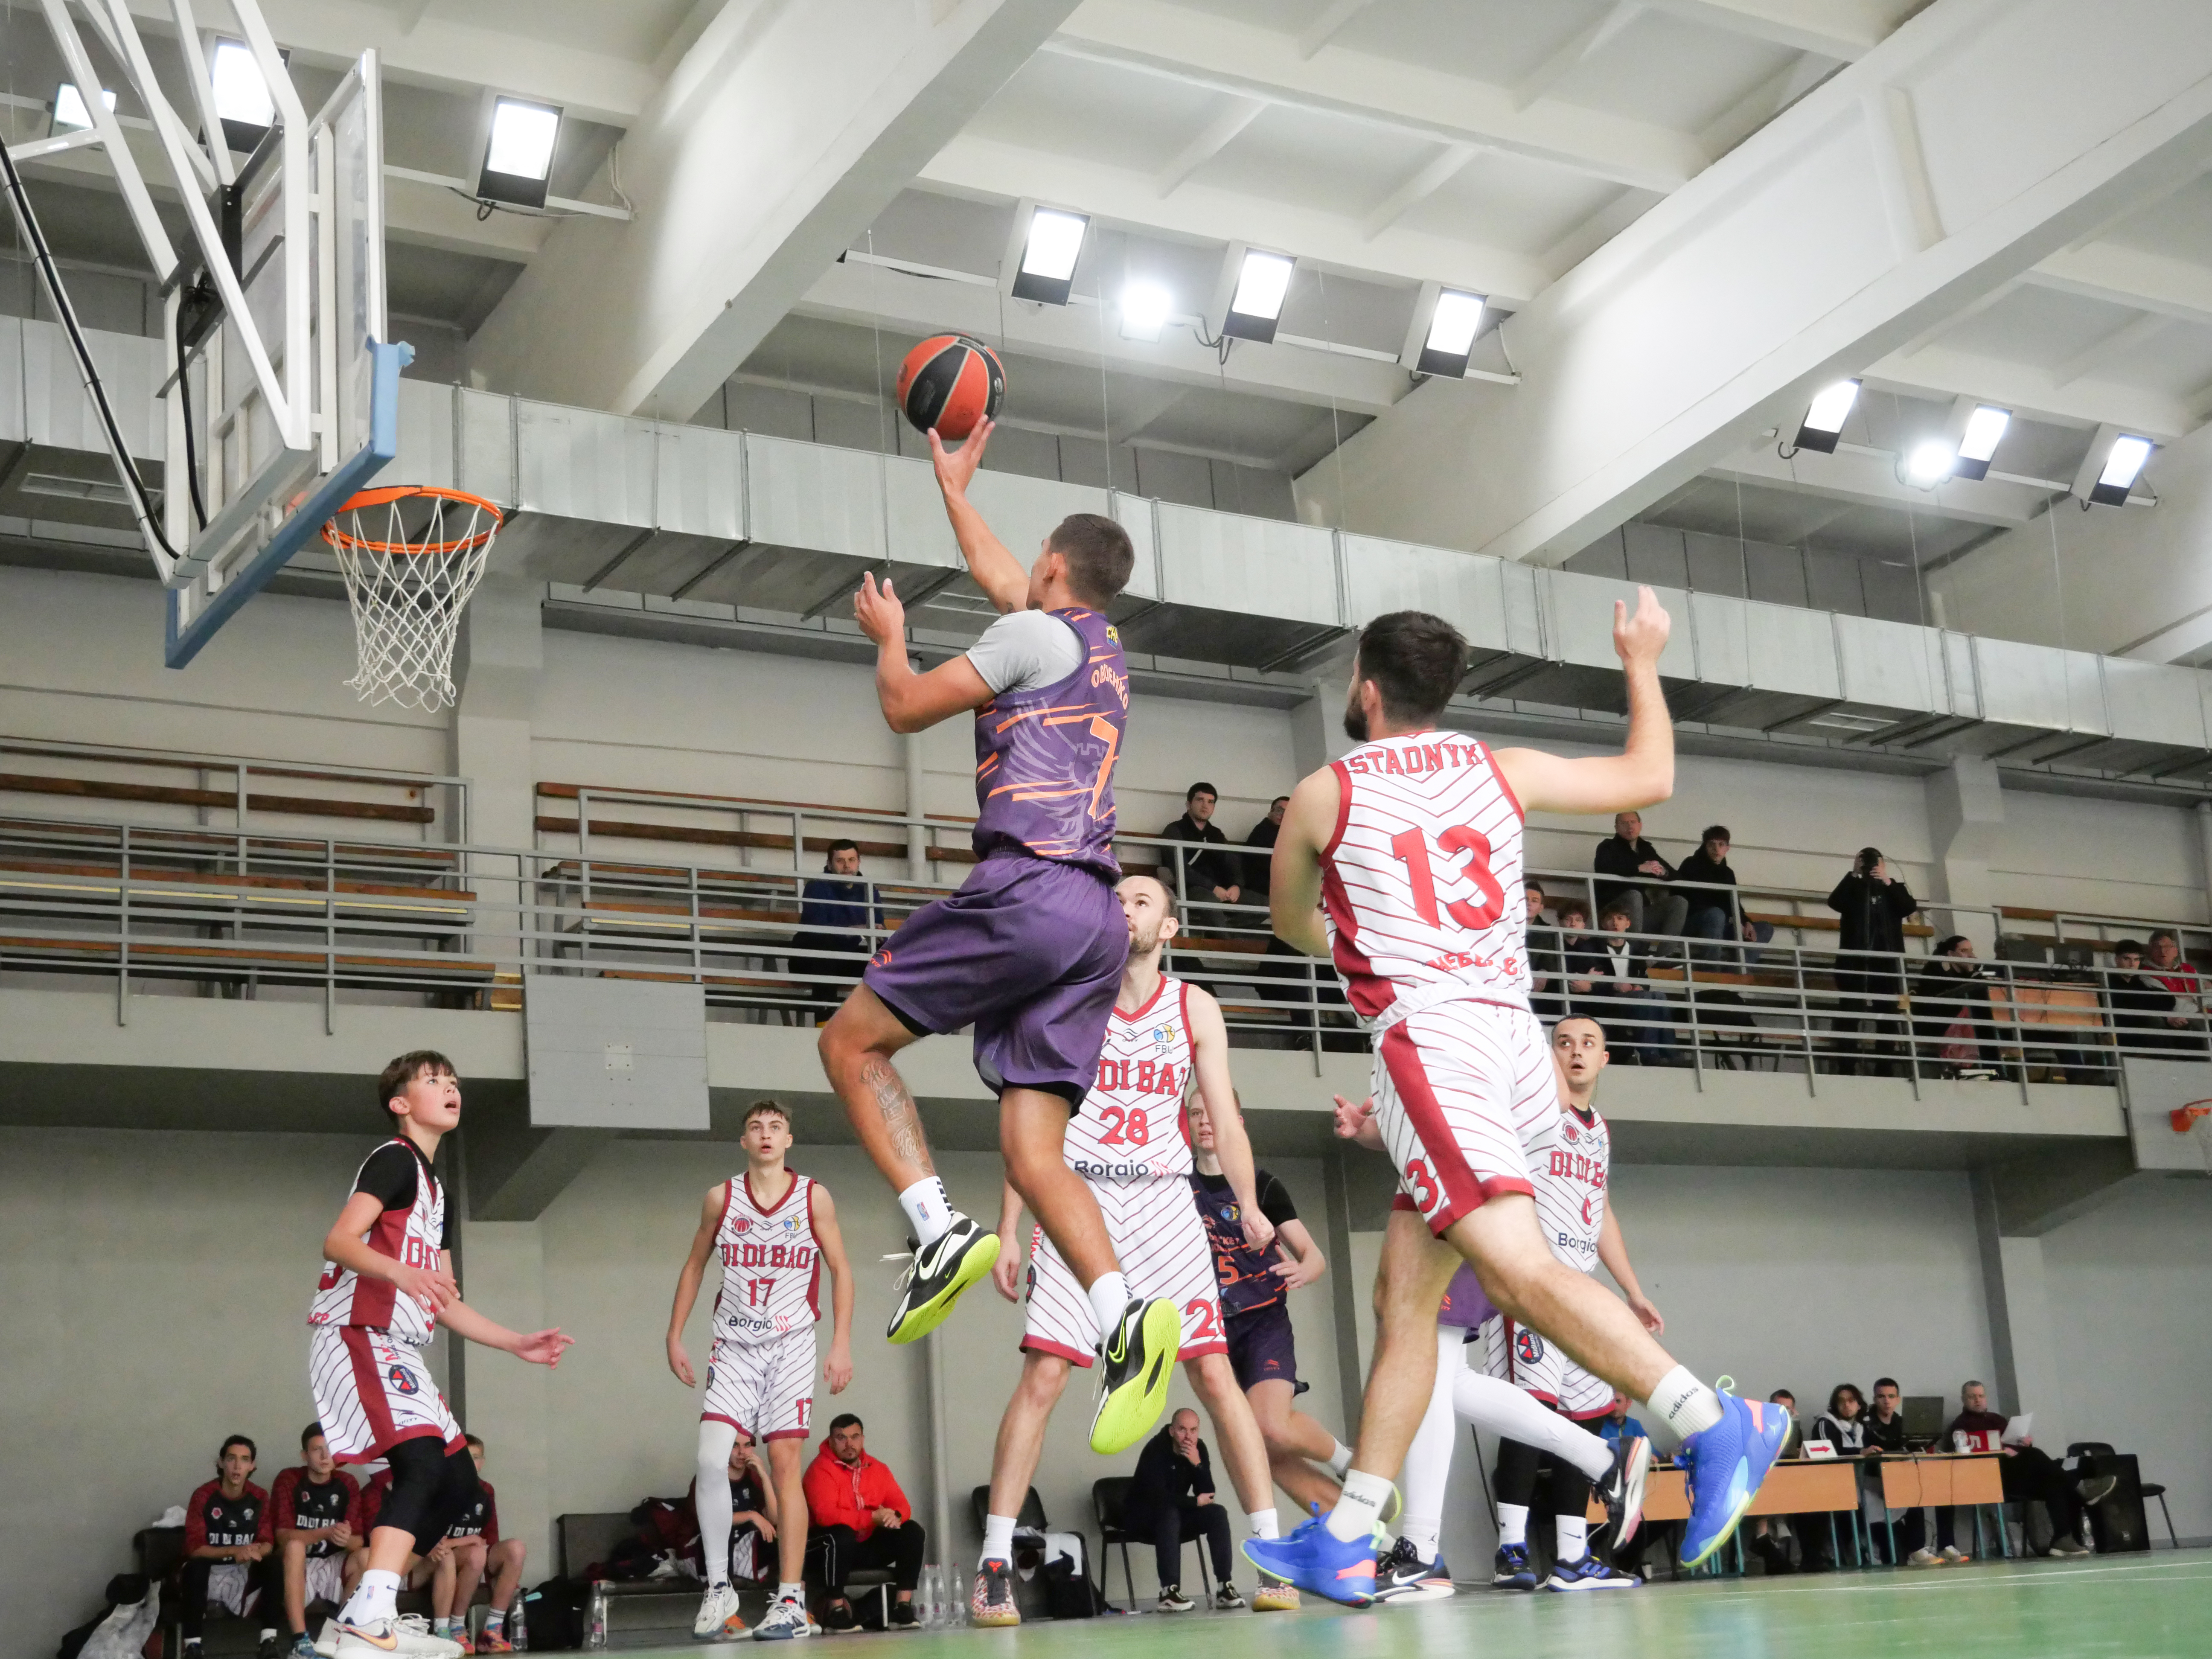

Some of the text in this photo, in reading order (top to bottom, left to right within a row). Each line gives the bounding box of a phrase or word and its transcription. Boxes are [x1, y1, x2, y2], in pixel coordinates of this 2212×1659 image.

[1087, 716, 1118, 819] 7
[1349, 744, 1484, 775] STADNYK
[1391, 824, 1505, 931] 13
[1136, 1060, 1187, 1096] BA
[1097, 1105, 1149, 1145] 28
[1407, 1158, 1439, 1214] 3
[1558, 1232, 1597, 1254] Borgio
[1218, 1255, 1239, 1284] 5
[748, 1278, 777, 1307] 17
[729, 1315, 772, 1332] Borgio
[1528, 1333, 1540, 1357] Midland
[1669, 1387, 1699, 1419] adidas
